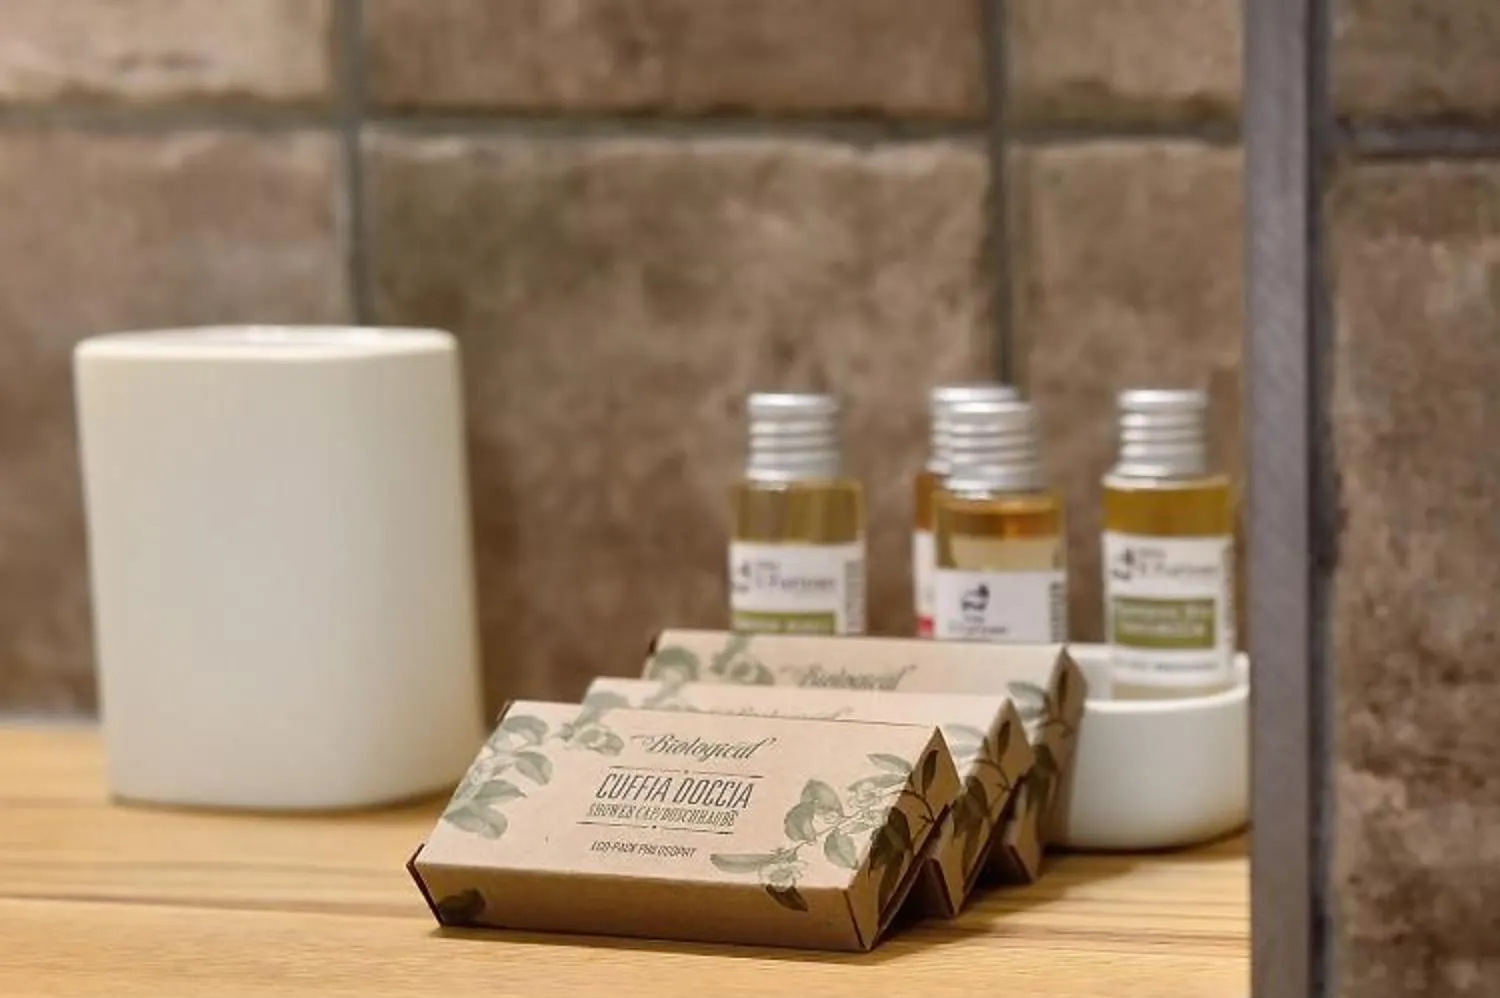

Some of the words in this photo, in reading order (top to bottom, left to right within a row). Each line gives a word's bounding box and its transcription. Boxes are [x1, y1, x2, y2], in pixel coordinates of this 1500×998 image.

[631, 734, 777, 763] Biological
[595, 773, 673, 803] CUFFIA
[672, 777, 755, 809] DOCCIA
[586, 803, 637, 820] SHOWER
